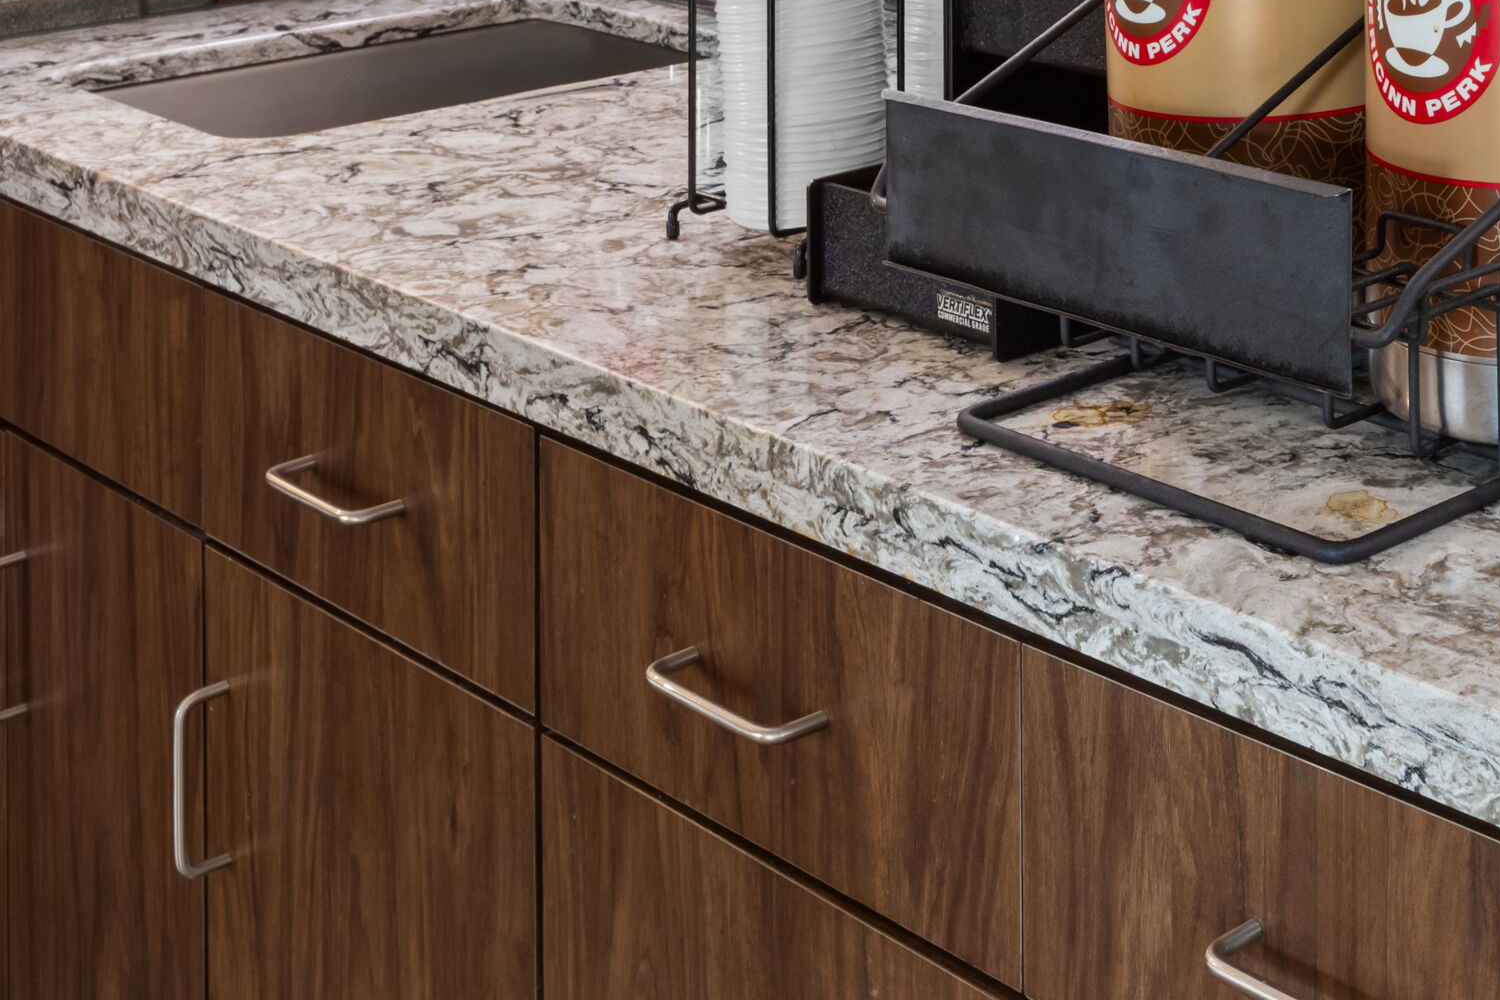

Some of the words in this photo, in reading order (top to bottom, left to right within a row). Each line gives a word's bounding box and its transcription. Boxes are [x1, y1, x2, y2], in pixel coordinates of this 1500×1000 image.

[1147, 2, 1202, 59] PERK
[1425, 56, 1493, 118] PERK
[936, 293, 990, 324] VERTIFLEX
[938, 310, 971, 327] COMMERCIAL
[971, 320, 990, 333] GRADE
